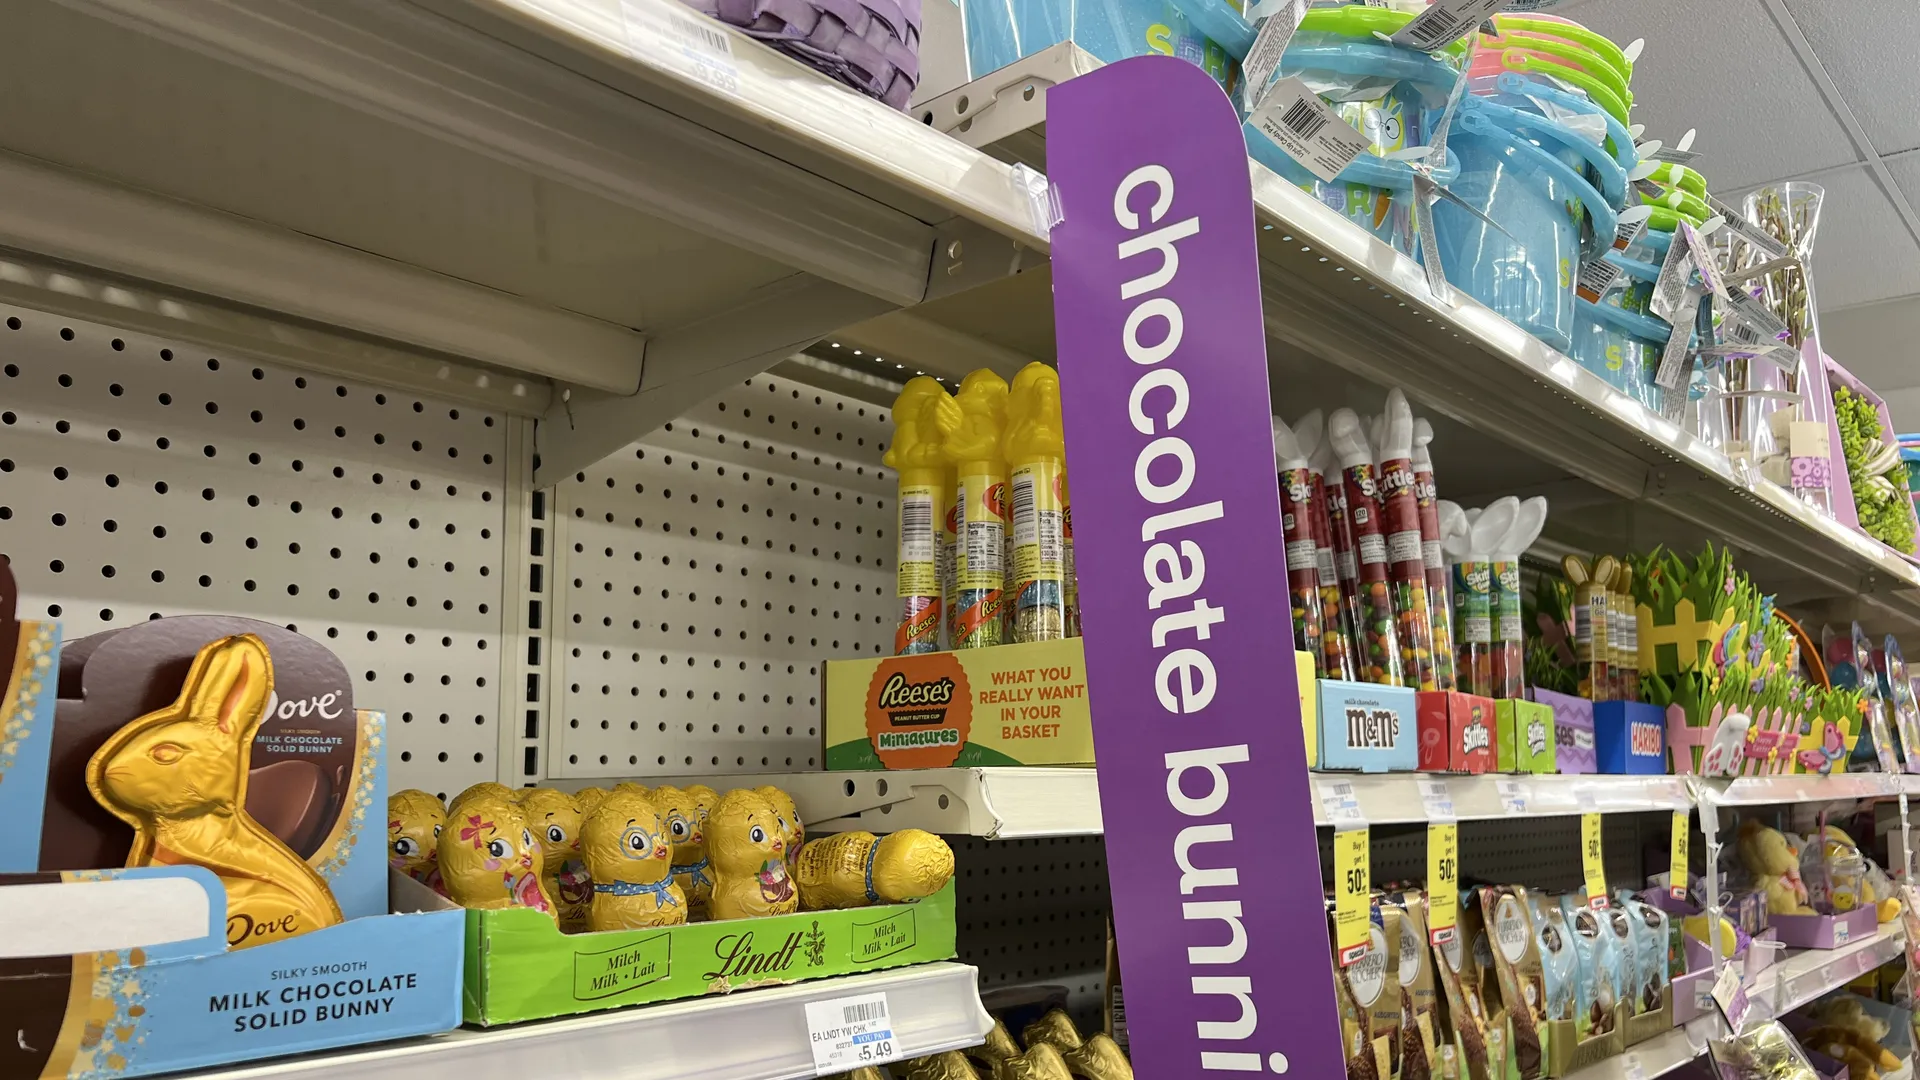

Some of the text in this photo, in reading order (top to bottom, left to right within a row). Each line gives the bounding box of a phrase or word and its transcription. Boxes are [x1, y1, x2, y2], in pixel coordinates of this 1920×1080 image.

[1114, 165, 1289, 1074] chocolate bunni
[991, 666, 1072, 686] WHAT YOU
[880, 674, 953, 707] Reese's
[980, 684, 1085, 705] REALLY WANT
[1001, 705, 1061, 722] IN YOUR
[256, 735, 343, 745] MILK CHOCOLATE
[880, 728, 958, 748] Miniatures
[1002, 723, 1061, 740] BASKET
[1631, 721, 1661, 757] HARIBO
[266, 745, 333, 753] SOLID BUNNY
[873, 922, 897, 940] Milch
[862, 932, 907, 957] Milk Lait
[606, 950, 641, 971] Milch
[702, 930, 804, 981] Lindt
[271, 961, 367, 981] SILKY SMOOTH
[590, 961, 656, 991] Milk Lait
[209, 973, 418, 1012] MILK CHOCOLATE
[234, 997, 395, 1033] SOLID BUNNY
[812, 1025, 867, 1043] EA LNDT YW CHK
[857, 1031, 886, 1043] YOU PAY
[858, 1041, 893, 1062] $5.49
